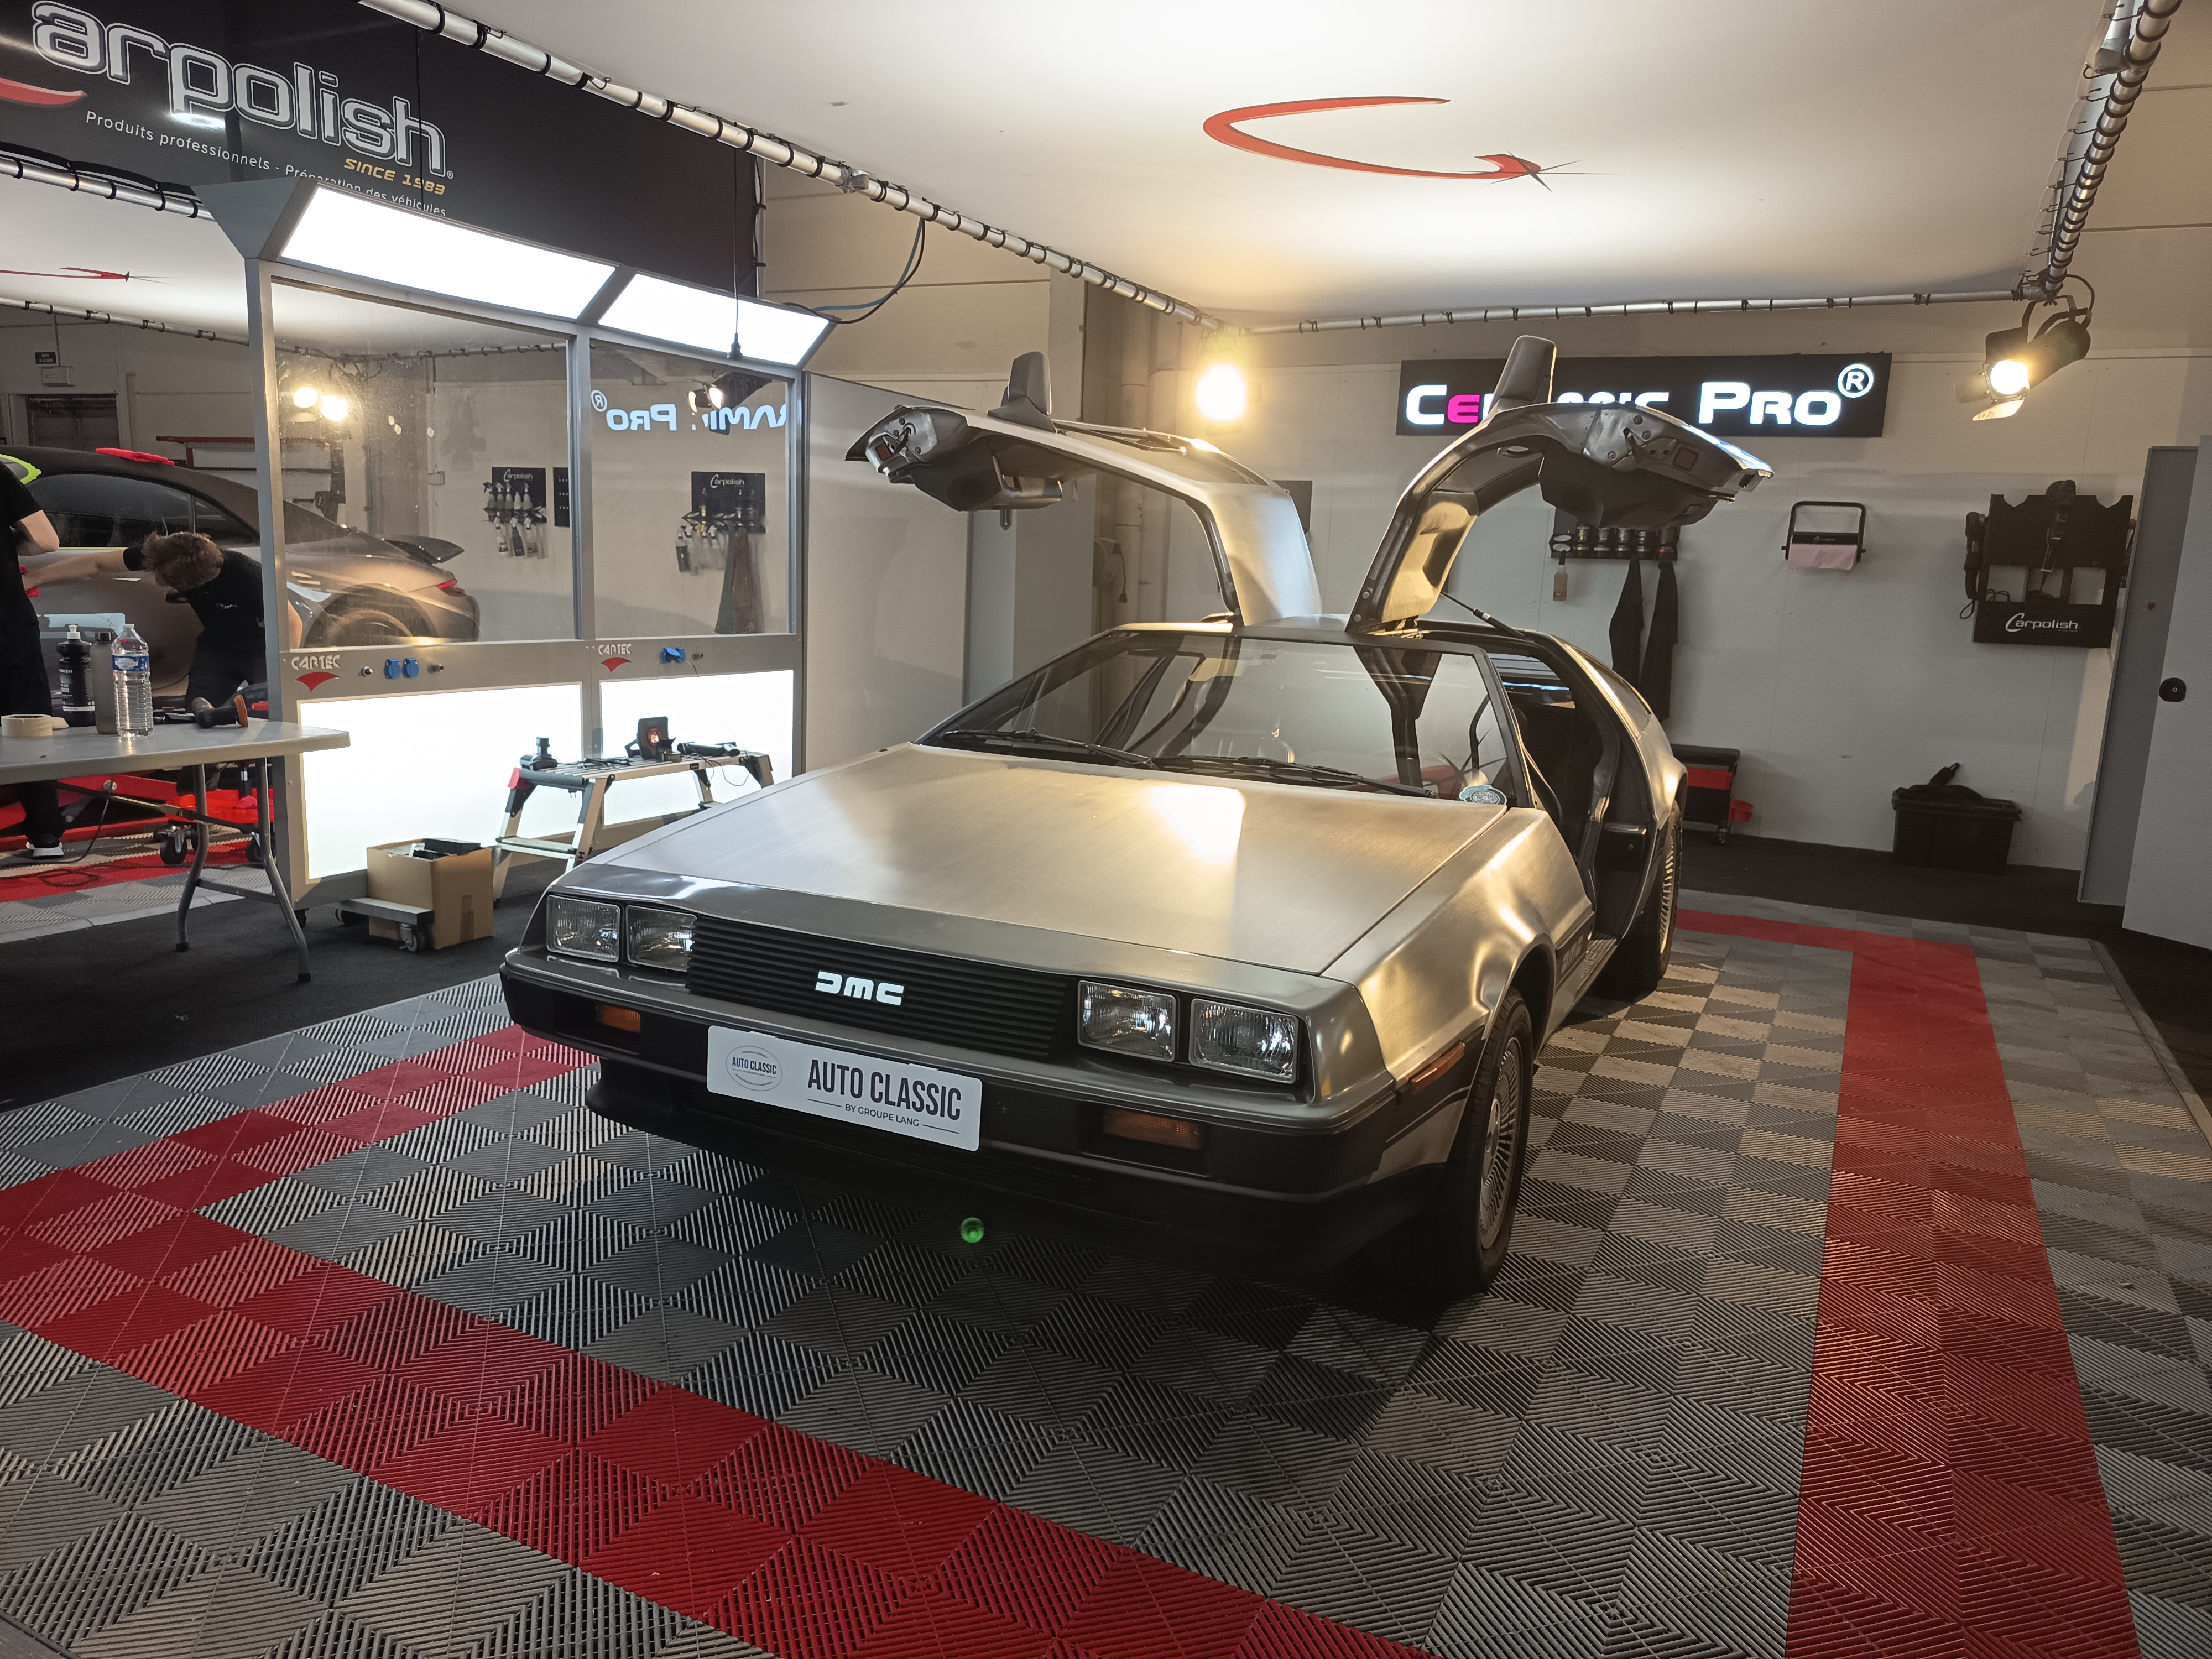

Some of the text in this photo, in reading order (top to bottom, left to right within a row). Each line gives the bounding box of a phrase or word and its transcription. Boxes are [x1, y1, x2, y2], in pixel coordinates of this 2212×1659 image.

[86, 110, 154, 141] Produits
[159, 134, 270, 170] professionnels
[392, 194, 446, 217] véhicules
[343, 158, 446, 195] SINCE 1983
[503, 469, 533, 482] Carpolish
[710, 474, 745, 488] Carpolish
[2005, 612, 2078, 632] Carpolish
[598, 643, 632, 655] CARTEC
[291, 655, 341, 670] CARTEC
[732, 1056, 749, 1069] AUTO
[750, 1060, 776, 1074] CLASSIC
[807, 1059, 961, 1121] AUTO CLASSIC
[858, 1107, 894, 1121] GROUPE
[896, 1114, 919, 1127] LANG
